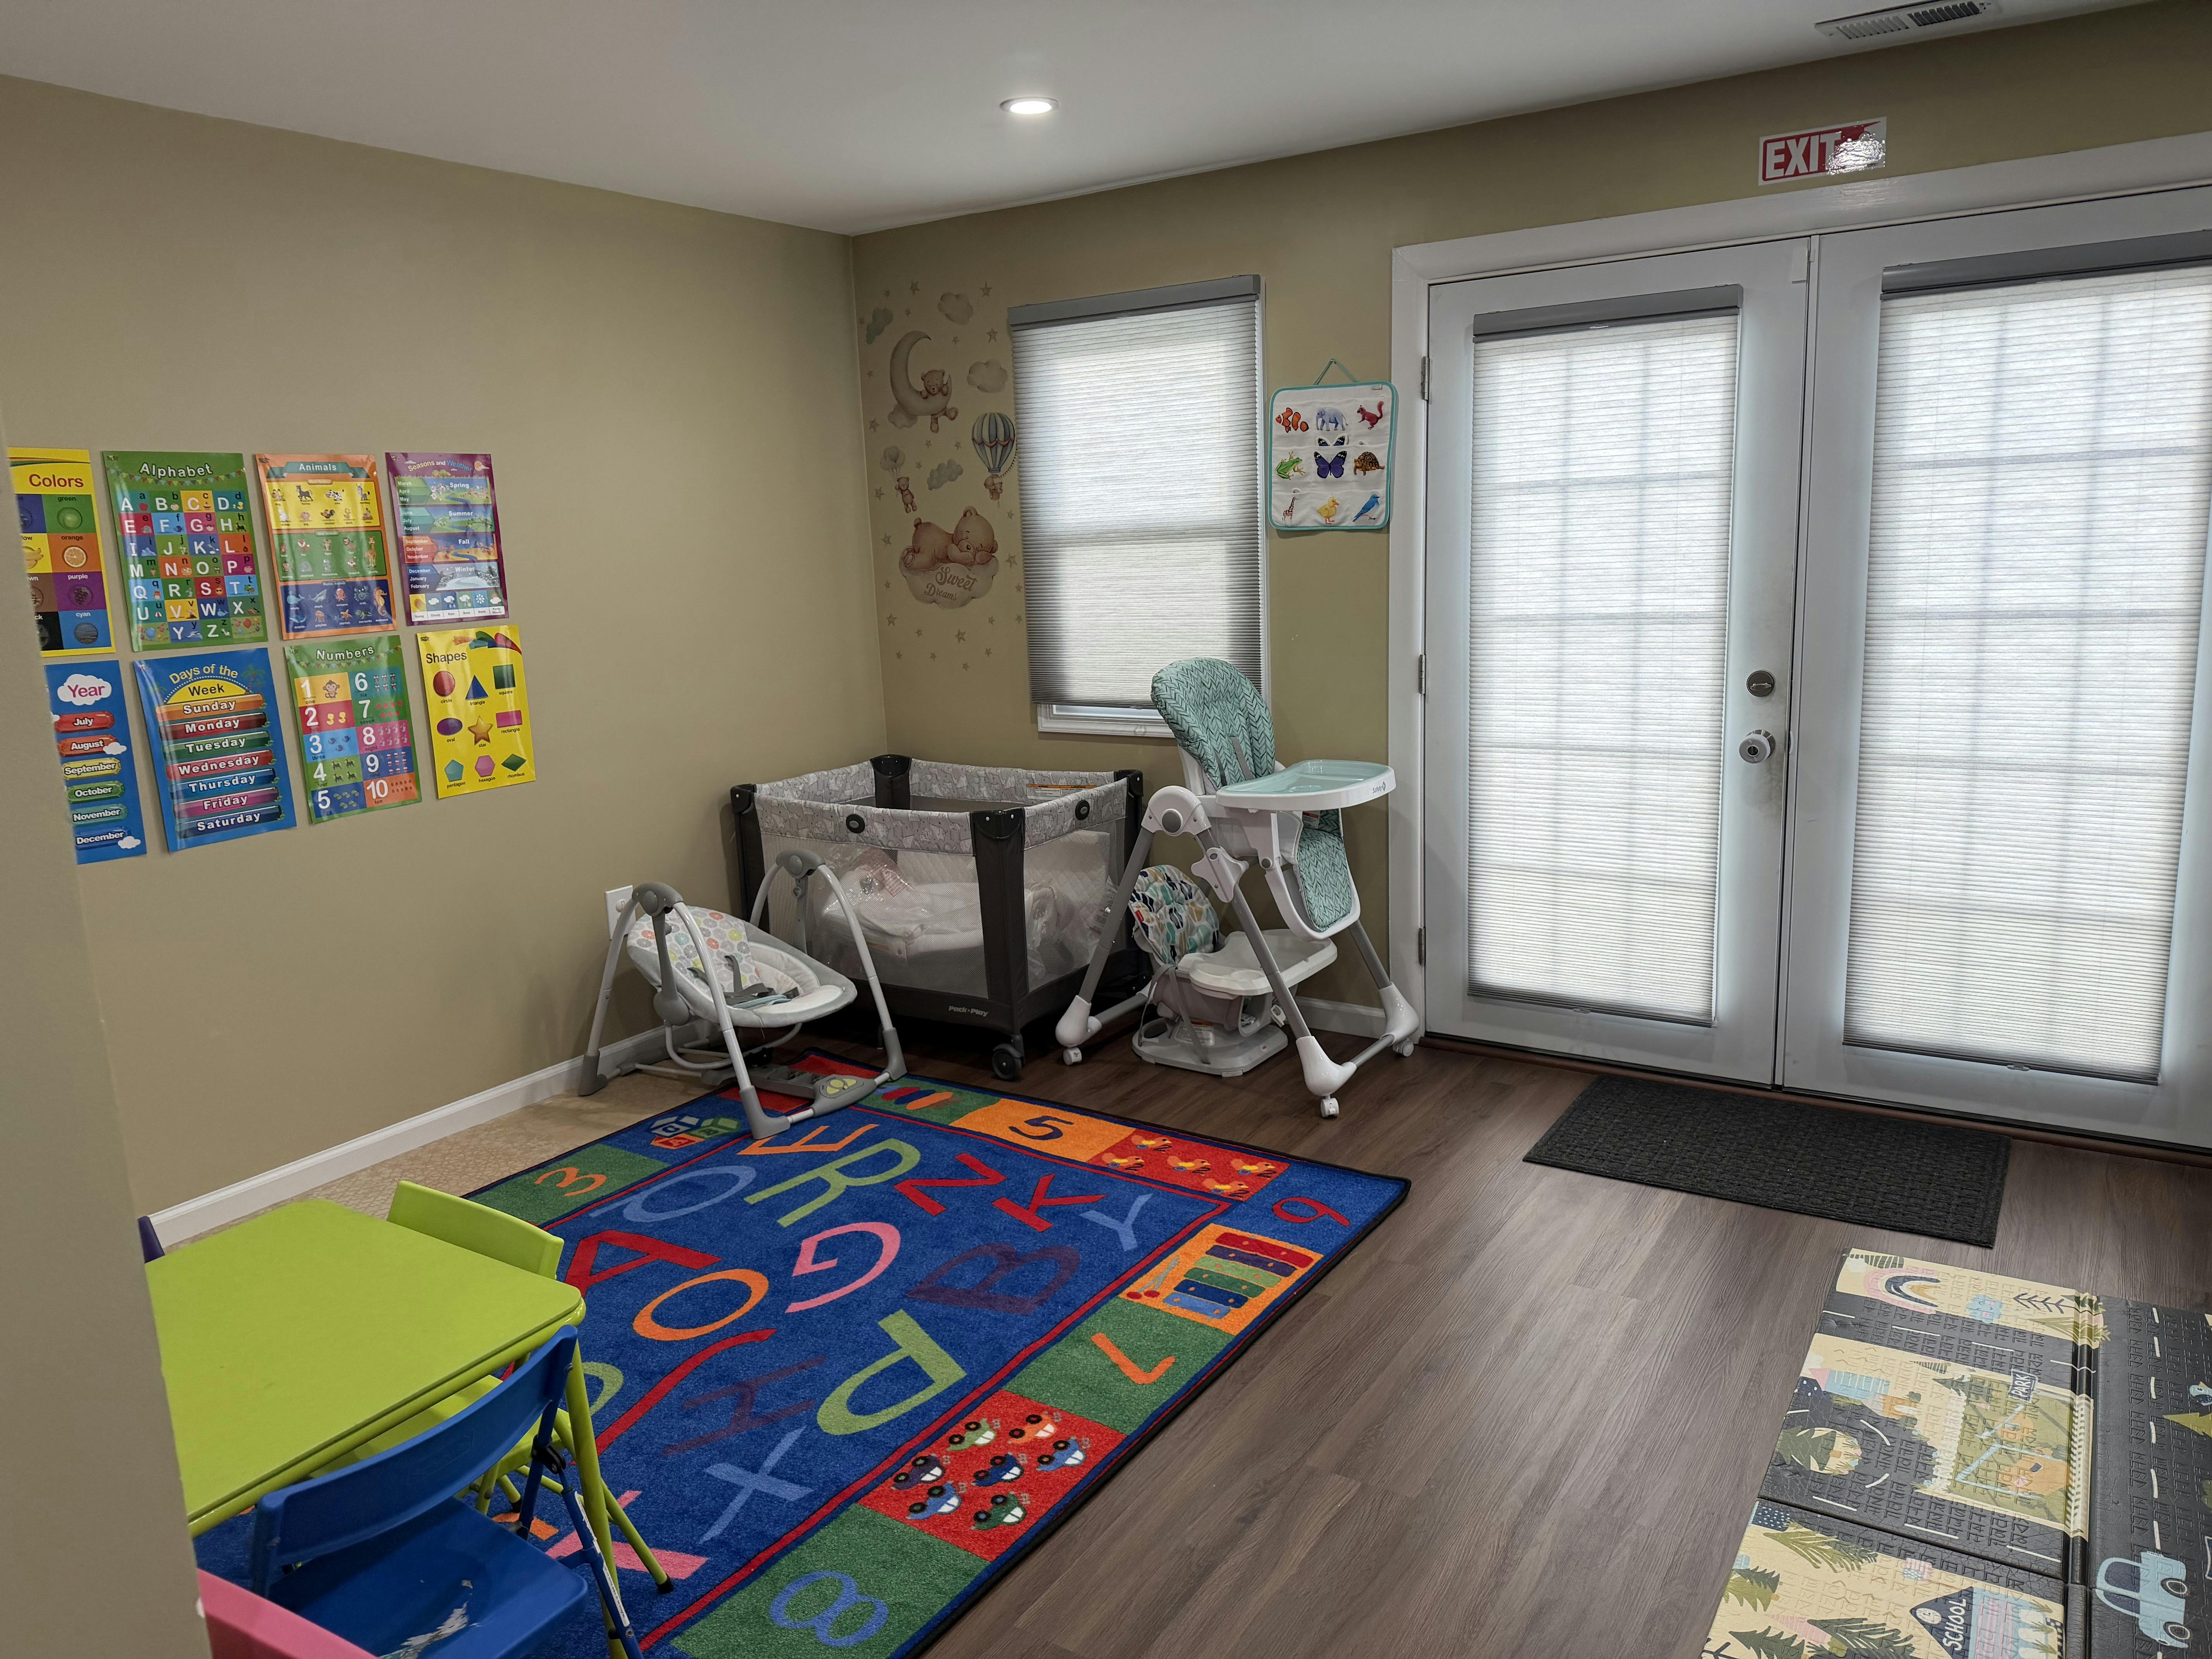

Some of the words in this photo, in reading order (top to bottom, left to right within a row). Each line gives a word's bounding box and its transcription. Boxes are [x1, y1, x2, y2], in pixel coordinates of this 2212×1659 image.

[1766, 131, 1841, 179] EXIT
[139, 462, 213, 479] Alphabet
[408, 460, 434, 471] Seasons
[447, 460, 472, 472] Weather
[29, 474, 84, 487] Colors
[122, 498, 133, 511] A
[155, 498, 167, 510] B
[187, 497, 199, 510] C
[218, 497, 229, 510] D
[125, 520, 136, 533] E
[160, 519, 169, 532] F
[190, 519, 203, 532] G
[221, 518, 232, 531] H
[163, 542, 172, 555] J
[194, 541, 206, 554] K
[225, 540, 235, 553] L
[130, 564, 143, 577] M
[165, 563, 177, 575] N
[196, 562, 209, 574] O
[227, 561, 237, 573] P
[936, 567, 977, 591] Sweet
[134, 586, 148, 599] Q
[169, 584, 181, 597] R
[201, 582, 211, 595] S
[229, 582, 240, 594] T
[924, 583, 957, 601] Dreams
[137, 607, 149, 620] U
[170, 605, 181, 618] V
[201, 603, 216, 616] W
[233, 601, 244, 614] X
[173, 627, 183, 639] Y
[207, 625, 218, 637] Z
[316, 646, 374, 660] Numbers
[426, 652, 467, 664] Shapes
[169, 666, 200, 685] Days
[203, 664, 216, 673] of
[220, 665, 238, 678] the
[355, 673, 368, 691] 6
[67, 685, 105, 698] Year
[189, 684, 224, 696] Week
[301, 679, 312, 698] 1
[183, 701, 236, 714] Sunday
[305, 707, 319, 726] 2
[359, 699, 371, 718] 7
[74, 718, 93, 726] July
[185, 719, 239, 733] Monday
[71, 740, 104, 750] August
[186, 737, 246, 753] Tuesday
[309, 735, 322, 754] 3
[362, 726, 376, 745] 8
[65, 763, 116, 775] September
[178, 755, 259, 775] Wednesday
[313, 762, 327, 781] 4
[366, 754, 379, 773] 9
[75, 787, 112, 797] October
[189, 775, 256, 792] Thursday
[366, 780, 388, 799] 10
[203, 795, 248, 810] Friday
[318, 790, 330, 809] 5
[73, 809, 120, 821] November
[198, 812, 260, 831] Saturday
[76, 832, 124, 844] December
[970, 1008, 988, 1017] Play
[1008, 1115, 1073, 1140] 5
[534, 1167, 607, 1196] 3
[744, 1138, 921, 1228] R
[991, 1173, 1108, 1233] K
[1079, 1193, 1154, 1252] Y
[564, 1230, 723, 1298] A
[784, 1222, 900, 1314] G
[905, 1243, 1081, 1315] B
[632, 1269, 769, 1341] O
[1090, 1333, 1176, 1384] 7
[817, 1309, 967, 1436] P
[2011, 1374, 2031, 1397] PARK
[699, 1424, 814, 1545] X
[770, 1570, 889, 1647] 8
[1943, 1597, 1966, 1651] SCHOOL
